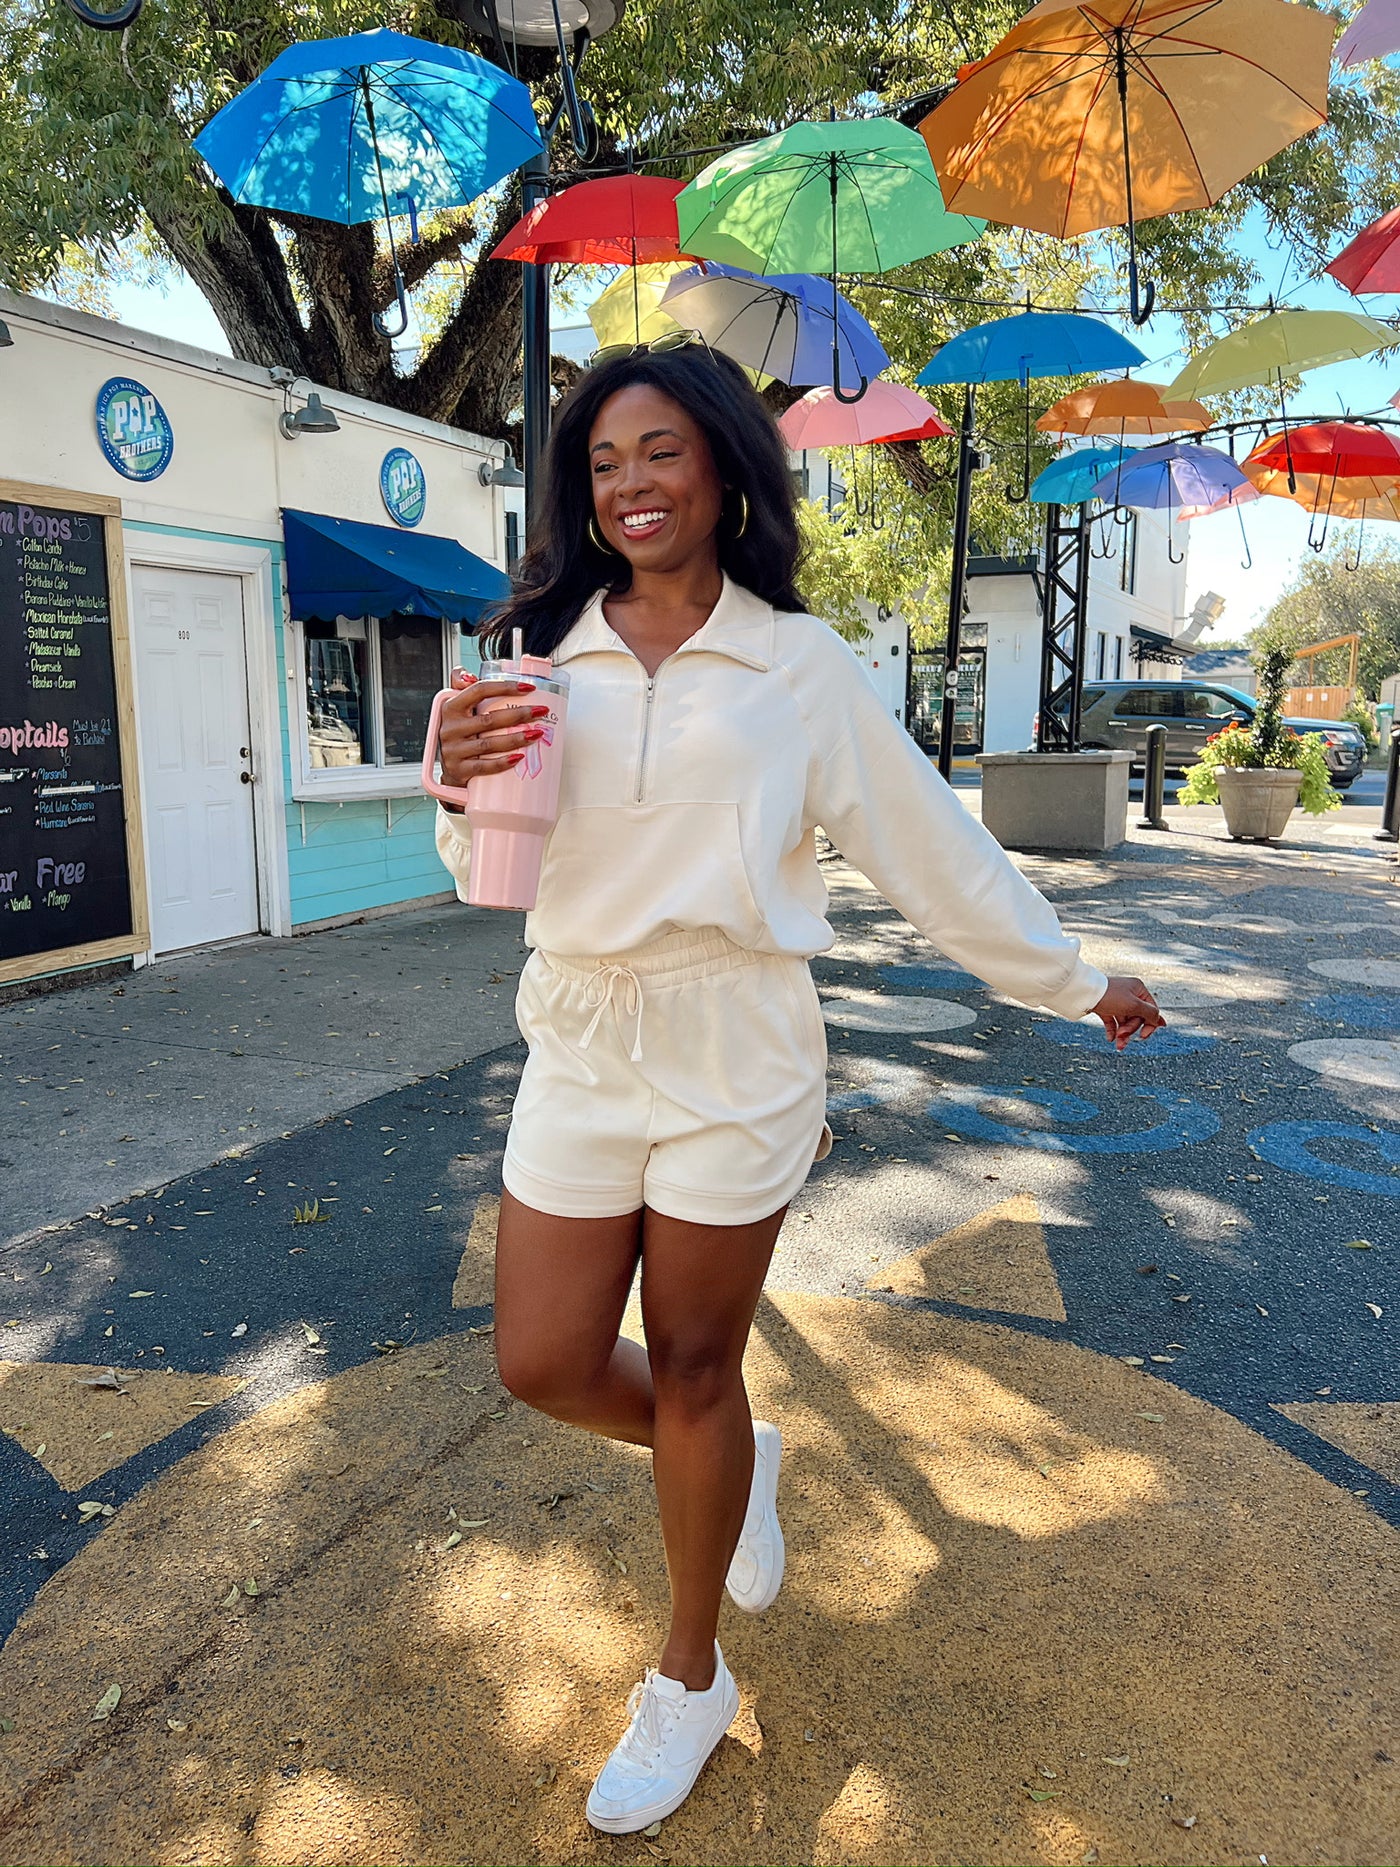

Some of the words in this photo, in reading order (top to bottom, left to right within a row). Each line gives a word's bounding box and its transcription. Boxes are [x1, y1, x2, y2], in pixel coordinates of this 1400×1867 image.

[119, 436, 162, 459] BROTHERS
[17, 505, 72, 543] Pops
[22, 537, 42, 552] Cotton
[43, 538, 62, 555] Candy
[69, 561, 86, 575] Honey
[25, 573, 53, 588] Birthday
[54, 576, 69, 590] Cake
[24, 590, 48, 605] Banana
[26, 609, 56, 623] Mexican
[28, 626, 49, 640] Salted
[50, 626, 74, 640] Caramel
[63, 643, 81, 656] Vanilla
[32, 674, 53, 689] Peaches
[58, 675, 77, 689] Cream
[100, 718, 112, 731] 21
[39, 801, 54, 814] Red
[36, 857, 86, 889] Free
[10, 894, 32, 912] Vanilla
[47, 889, 72, 911] Mango
